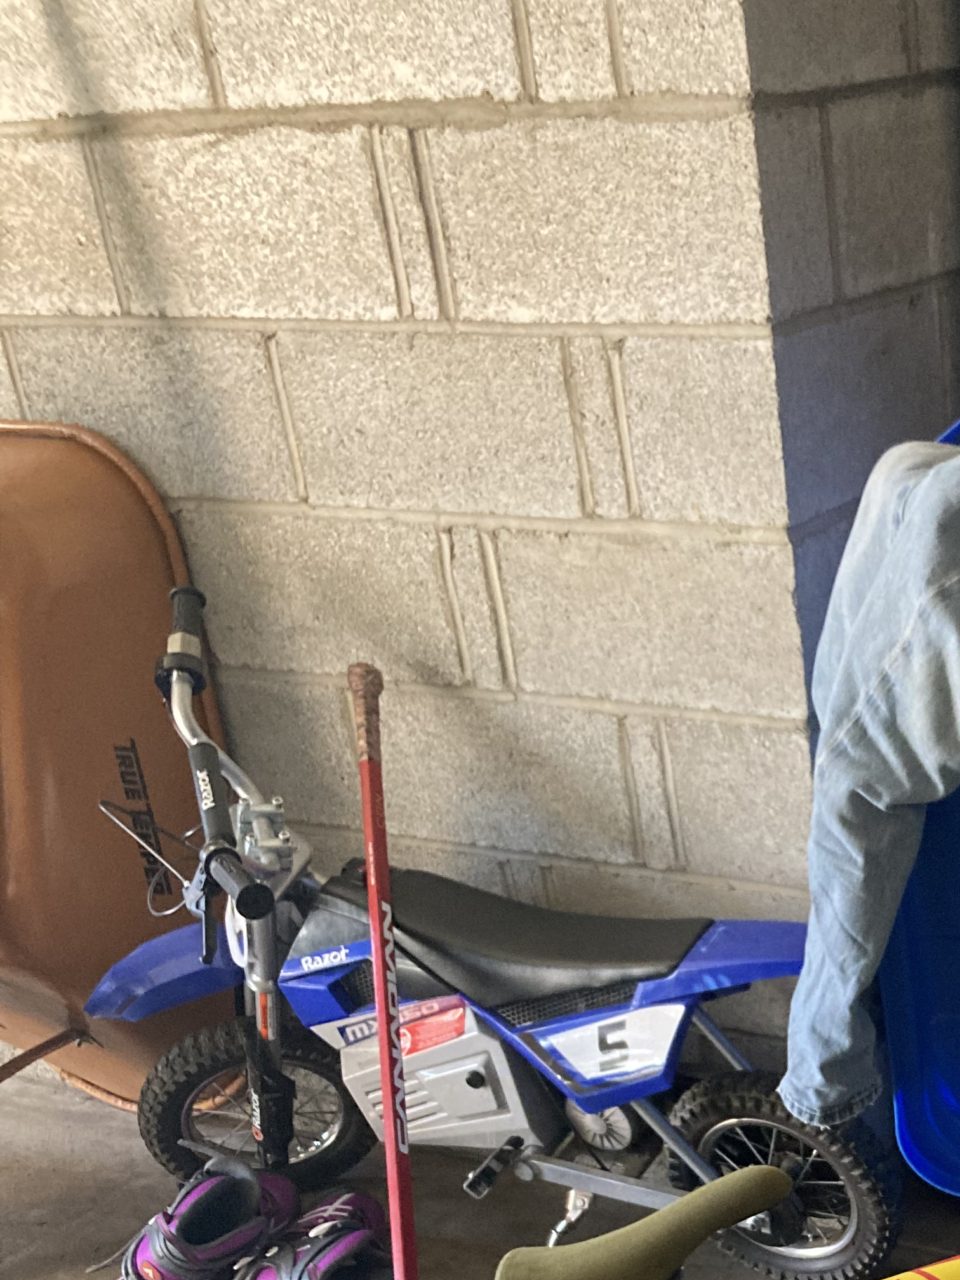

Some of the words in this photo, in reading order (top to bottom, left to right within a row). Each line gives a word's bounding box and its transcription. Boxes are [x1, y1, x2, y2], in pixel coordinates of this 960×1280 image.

[113, 737, 150, 800] TRUE
[197, 769, 215, 810] Razor
[301, 945, 349, 972] Razor
